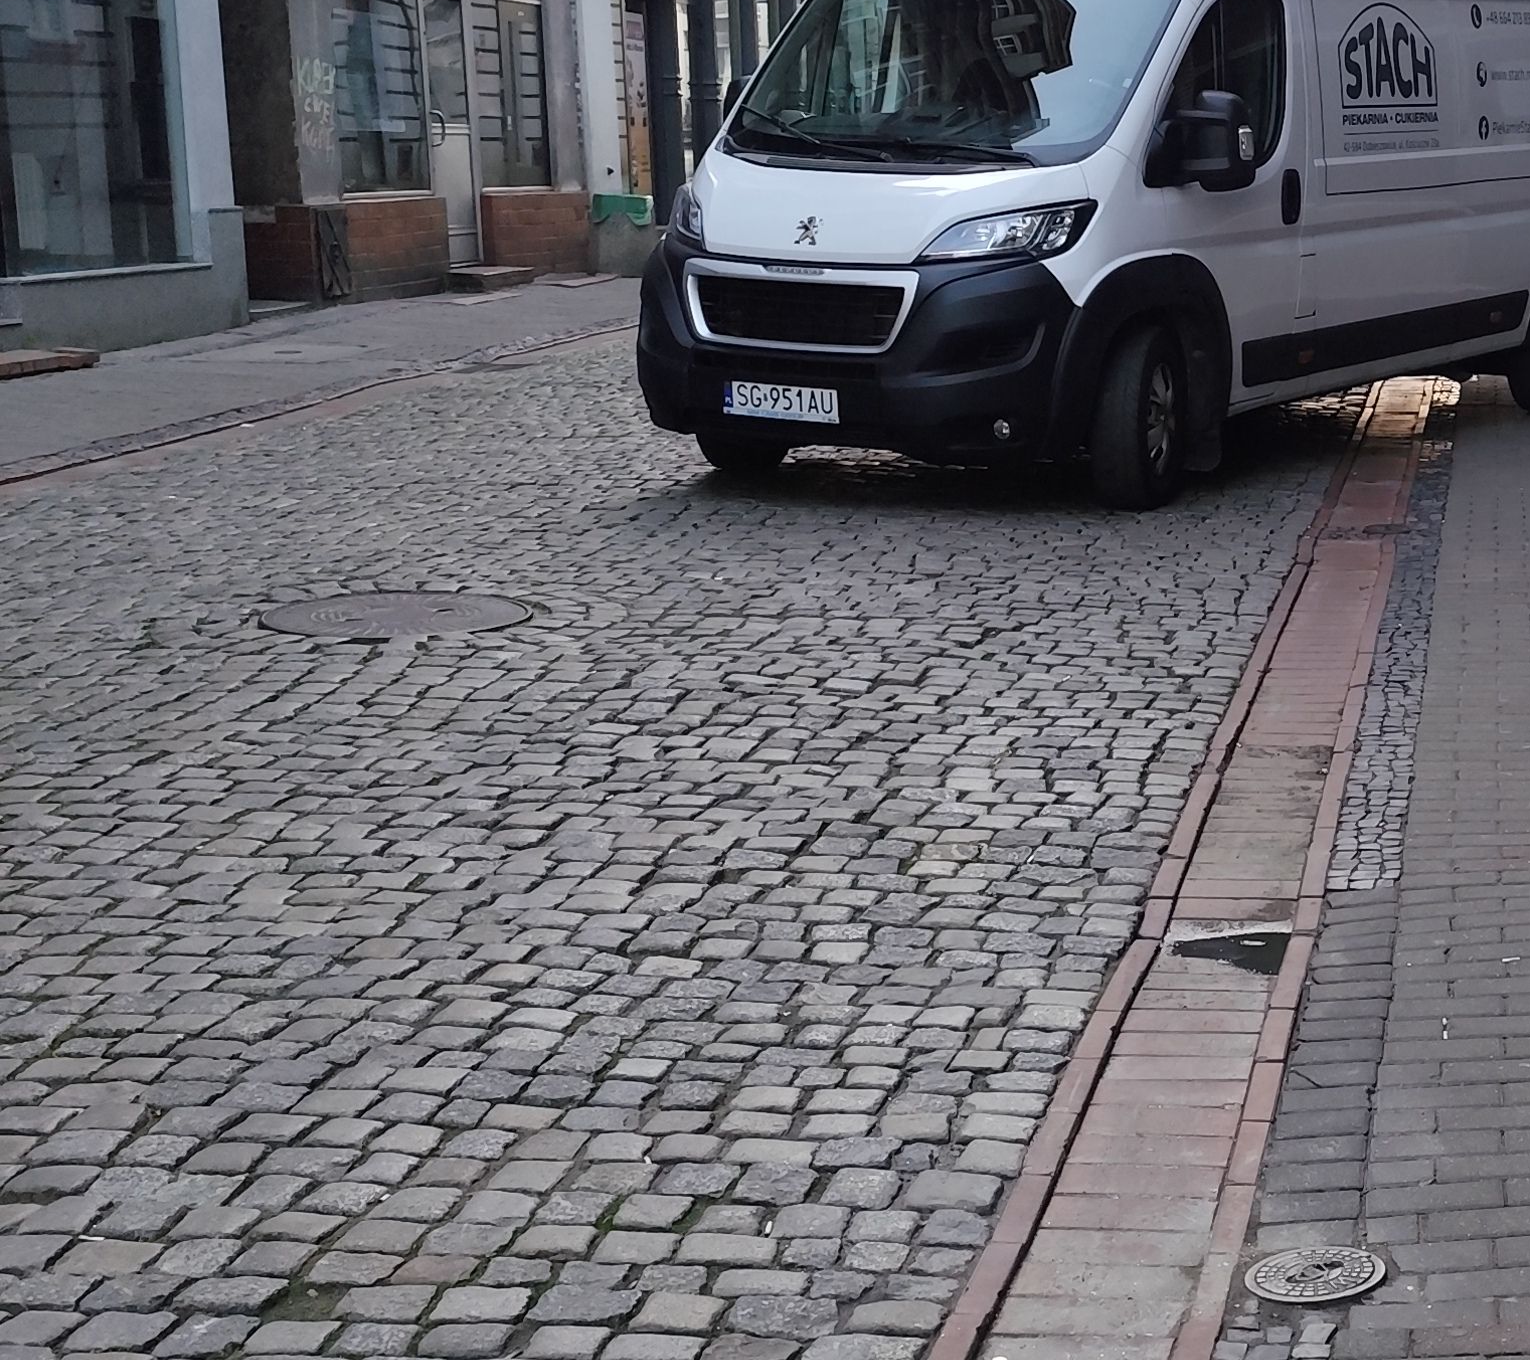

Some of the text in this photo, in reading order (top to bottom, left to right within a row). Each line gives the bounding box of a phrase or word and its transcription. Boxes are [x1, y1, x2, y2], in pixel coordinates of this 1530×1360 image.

[1344, 16, 1432, 99] STACH
[1342, 112, 1439, 126] PIEKARNIA CUKIERNIA
[769, 387, 834, 414] 951AU
